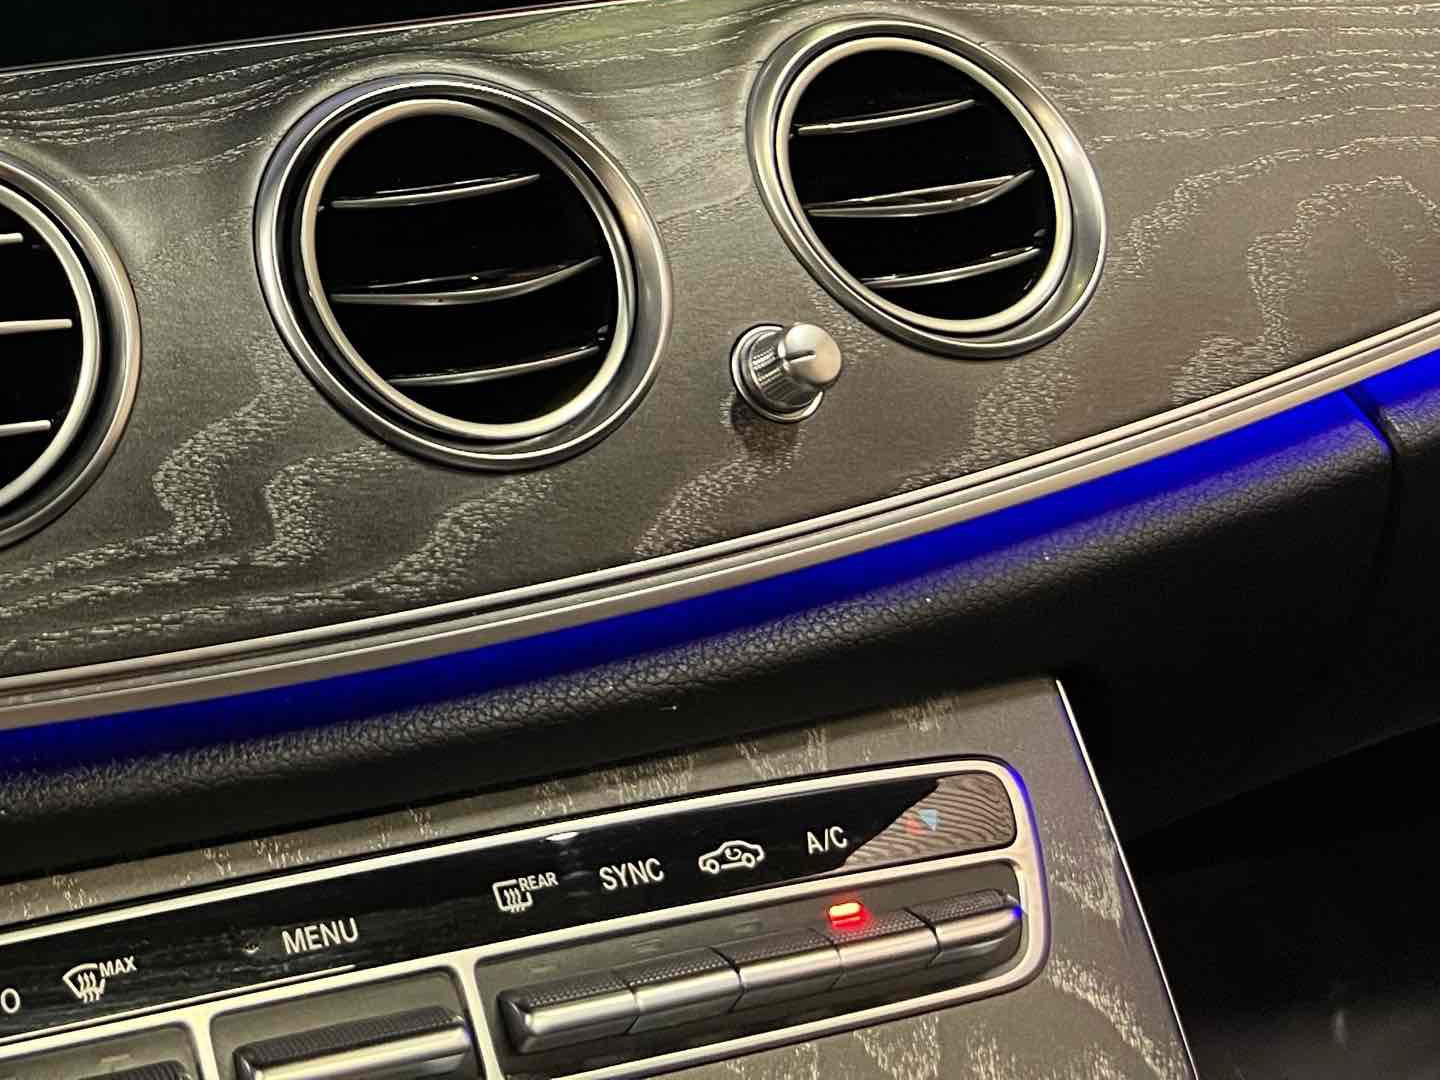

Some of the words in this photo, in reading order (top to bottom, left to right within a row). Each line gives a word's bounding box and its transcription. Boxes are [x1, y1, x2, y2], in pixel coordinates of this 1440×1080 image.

[806, 825, 849, 854] A/C
[518, 872, 559, 892] REAR
[598, 858, 665, 892] SYNC
[280, 917, 359, 955] MENU
[98, 955, 137, 978] MAX
